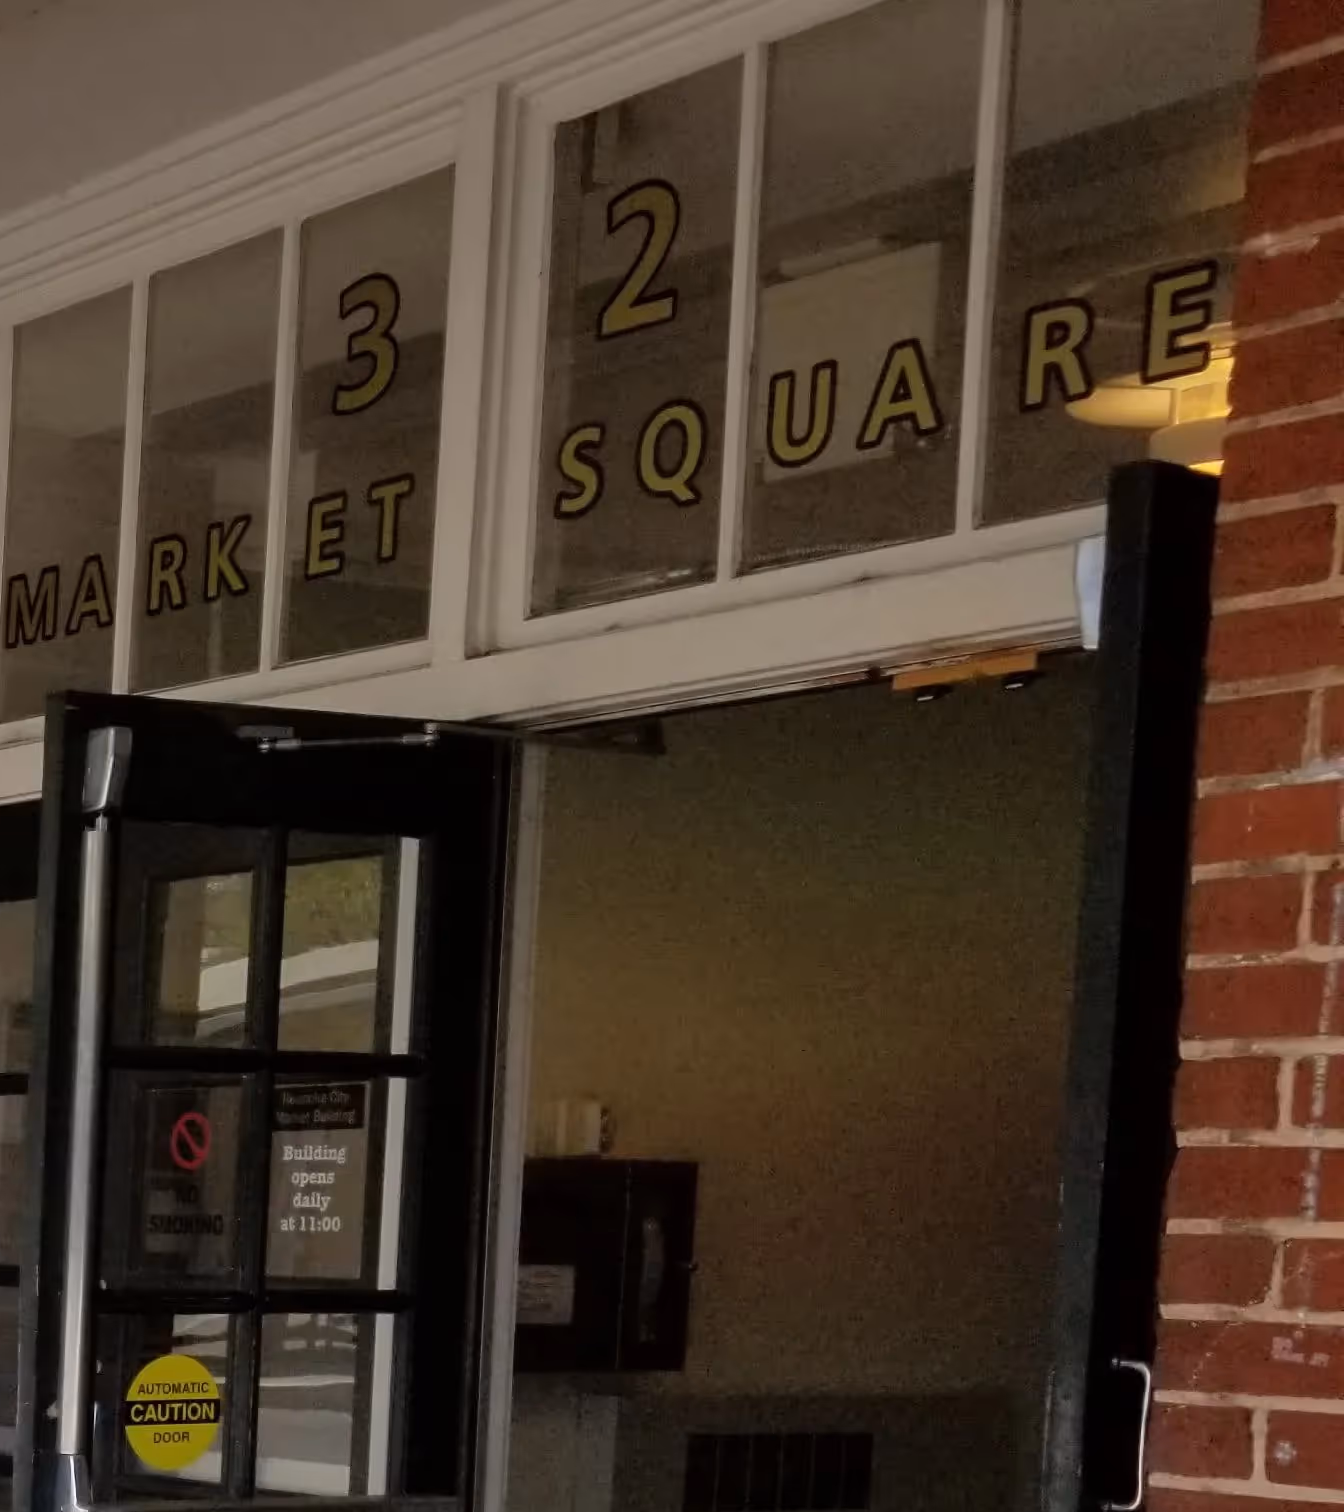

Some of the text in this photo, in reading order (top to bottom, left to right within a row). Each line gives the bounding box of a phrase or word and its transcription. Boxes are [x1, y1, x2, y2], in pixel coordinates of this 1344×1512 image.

[5, 260, 1217, 650] MARKET SQUARE
[282, 1145, 346, 1165] Building
[291, 1169, 335, 1187] opens
[292, 1191, 331, 1212] daily
[280, 1215, 342, 1233] at 11:00
[136, 1381, 210, 1397] AUTOMATIC
[129, 1402, 216, 1424] CAUTION
[152, 1430, 191, 1445] DOOR
